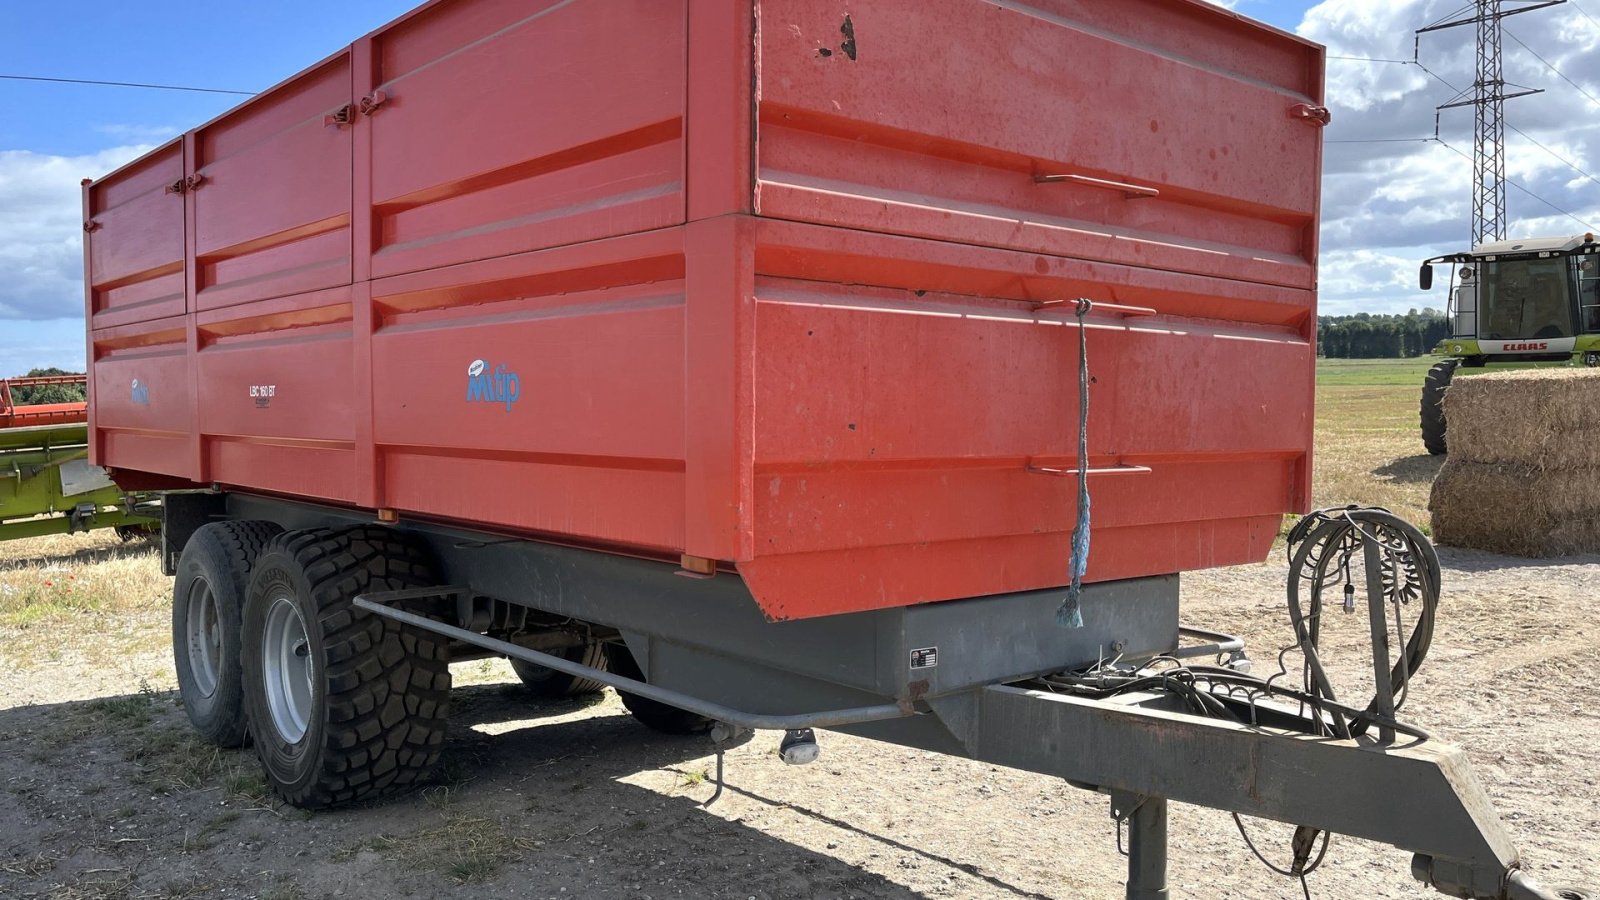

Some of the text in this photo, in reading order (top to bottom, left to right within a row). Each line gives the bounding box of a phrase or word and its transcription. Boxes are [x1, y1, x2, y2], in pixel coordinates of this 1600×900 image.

[1503, 342, 1548, 351] CLAAS
[249, 385, 259, 397] LBC
[269, 384, 276, 397] BT
